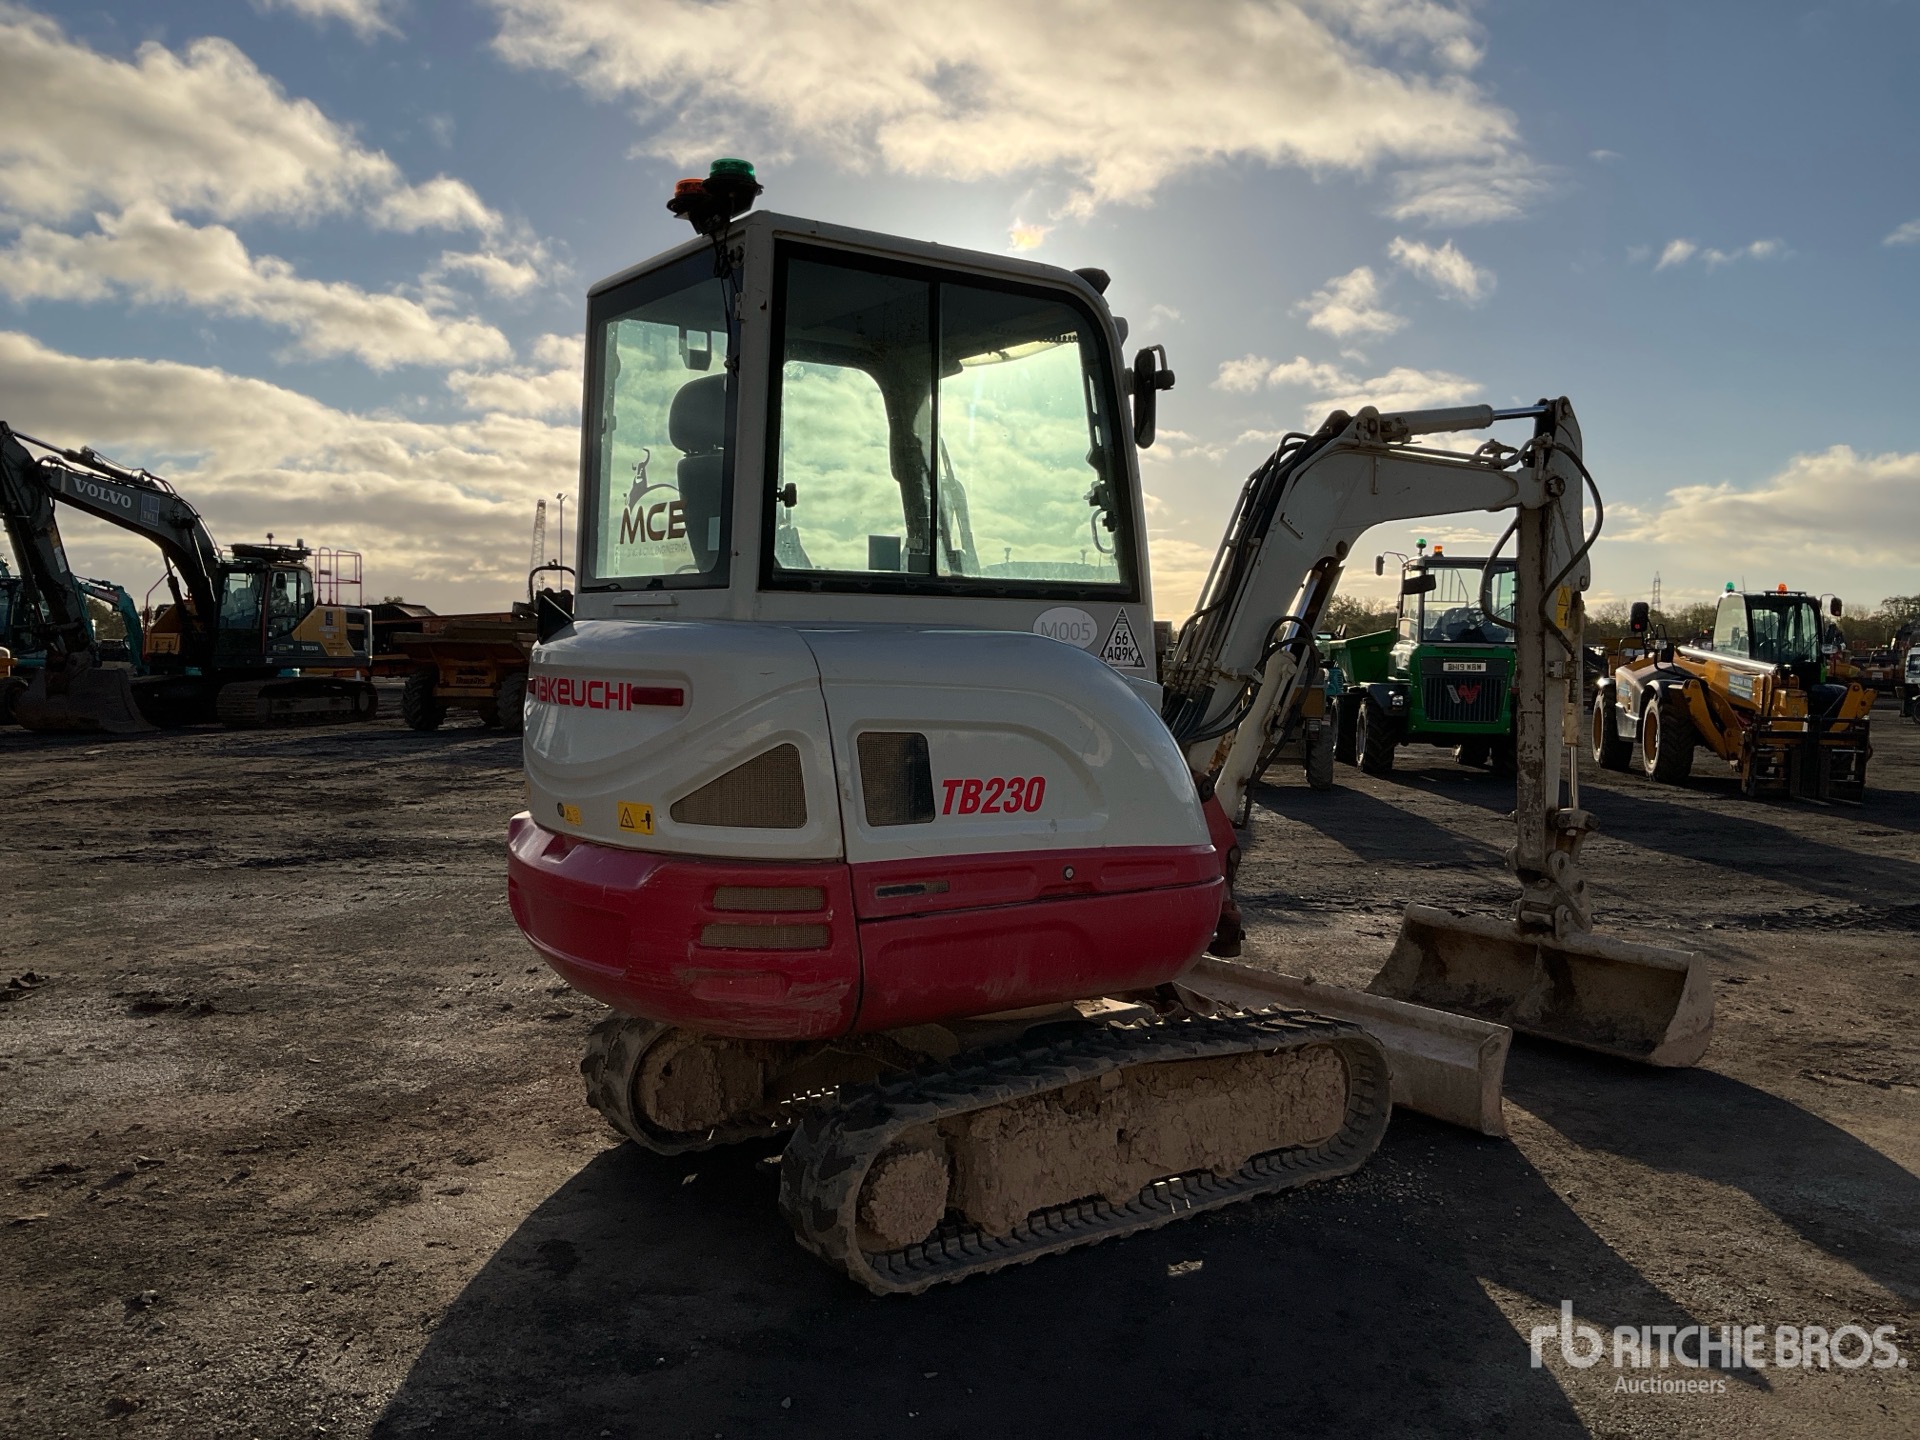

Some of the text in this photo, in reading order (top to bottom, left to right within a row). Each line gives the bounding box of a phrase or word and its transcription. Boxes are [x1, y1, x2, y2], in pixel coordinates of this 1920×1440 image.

[72, 477, 132, 508] VOLVO
[1041, 622, 1091, 640] M005
[1115, 631, 1128, 645] 66
[1107, 647, 1135, 661] AQ9K
[942, 776, 1046, 815] TB230
